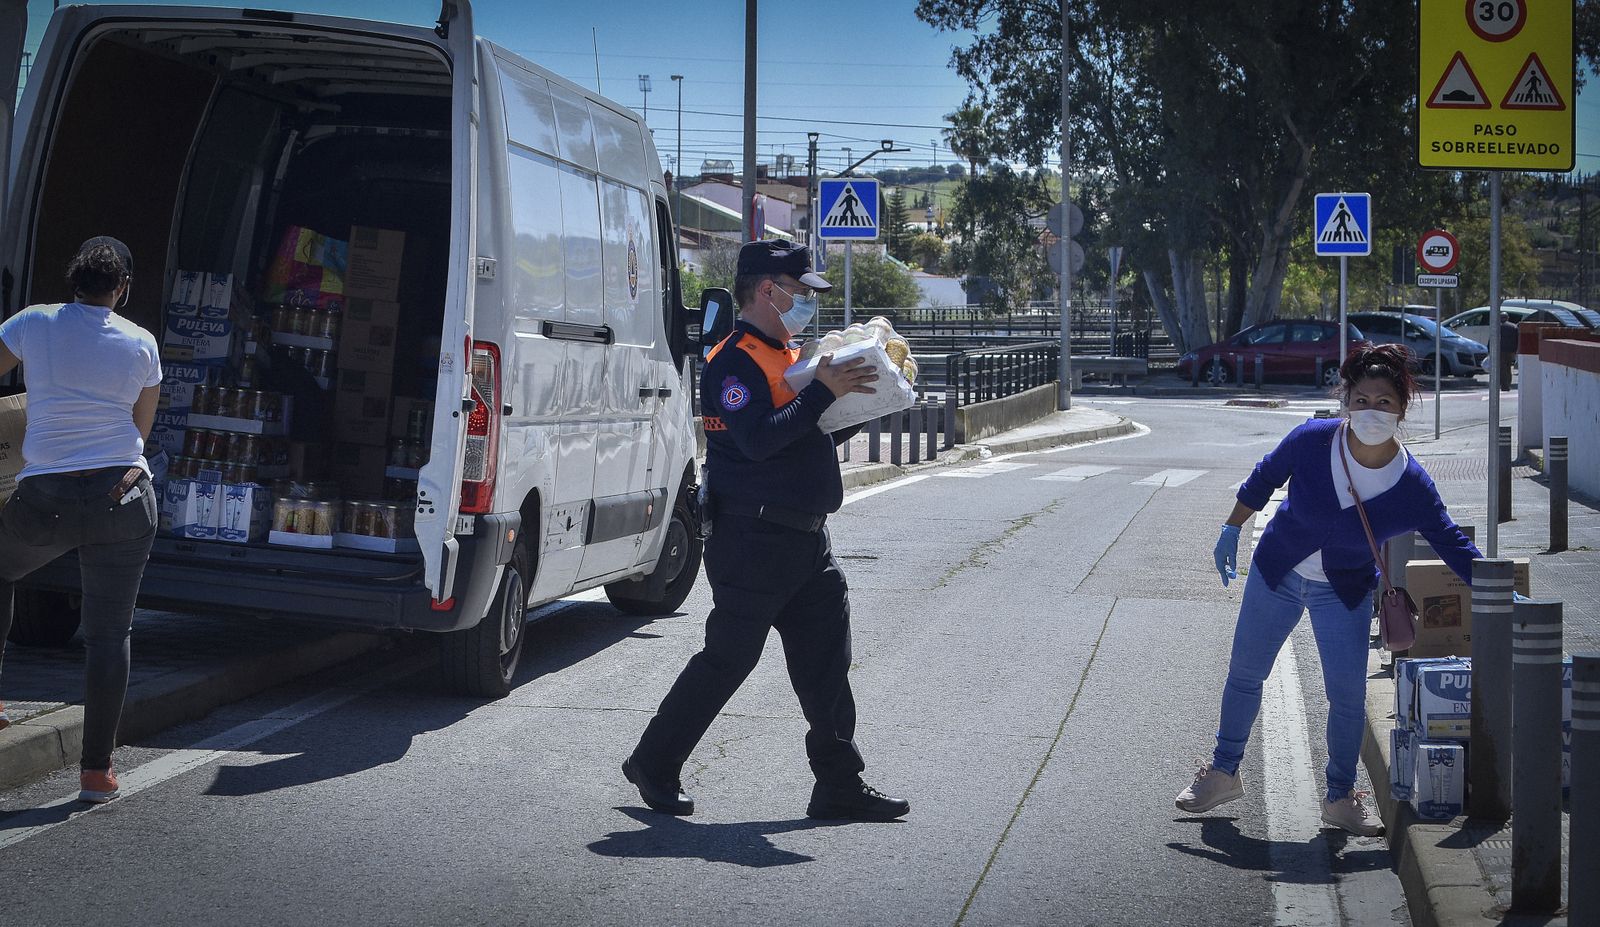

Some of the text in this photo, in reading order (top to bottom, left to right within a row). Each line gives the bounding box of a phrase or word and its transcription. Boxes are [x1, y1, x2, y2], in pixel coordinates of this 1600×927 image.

[1479, 1, 1514, 22] 30
[1473, 124, 1518, 137] PASO
[1431, 141, 1560, 155] SOBREELEVADO
[1419, 277, 1437, 285] EXCEPTO
[176, 318, 225, 333] PULEVA
[182, 338, 210, 347] ENTERA
[161, 366, 199, 378] ULEVA
[160, 385, 186, 394] NTERA
[150, 432, 175, 441] NTERA
